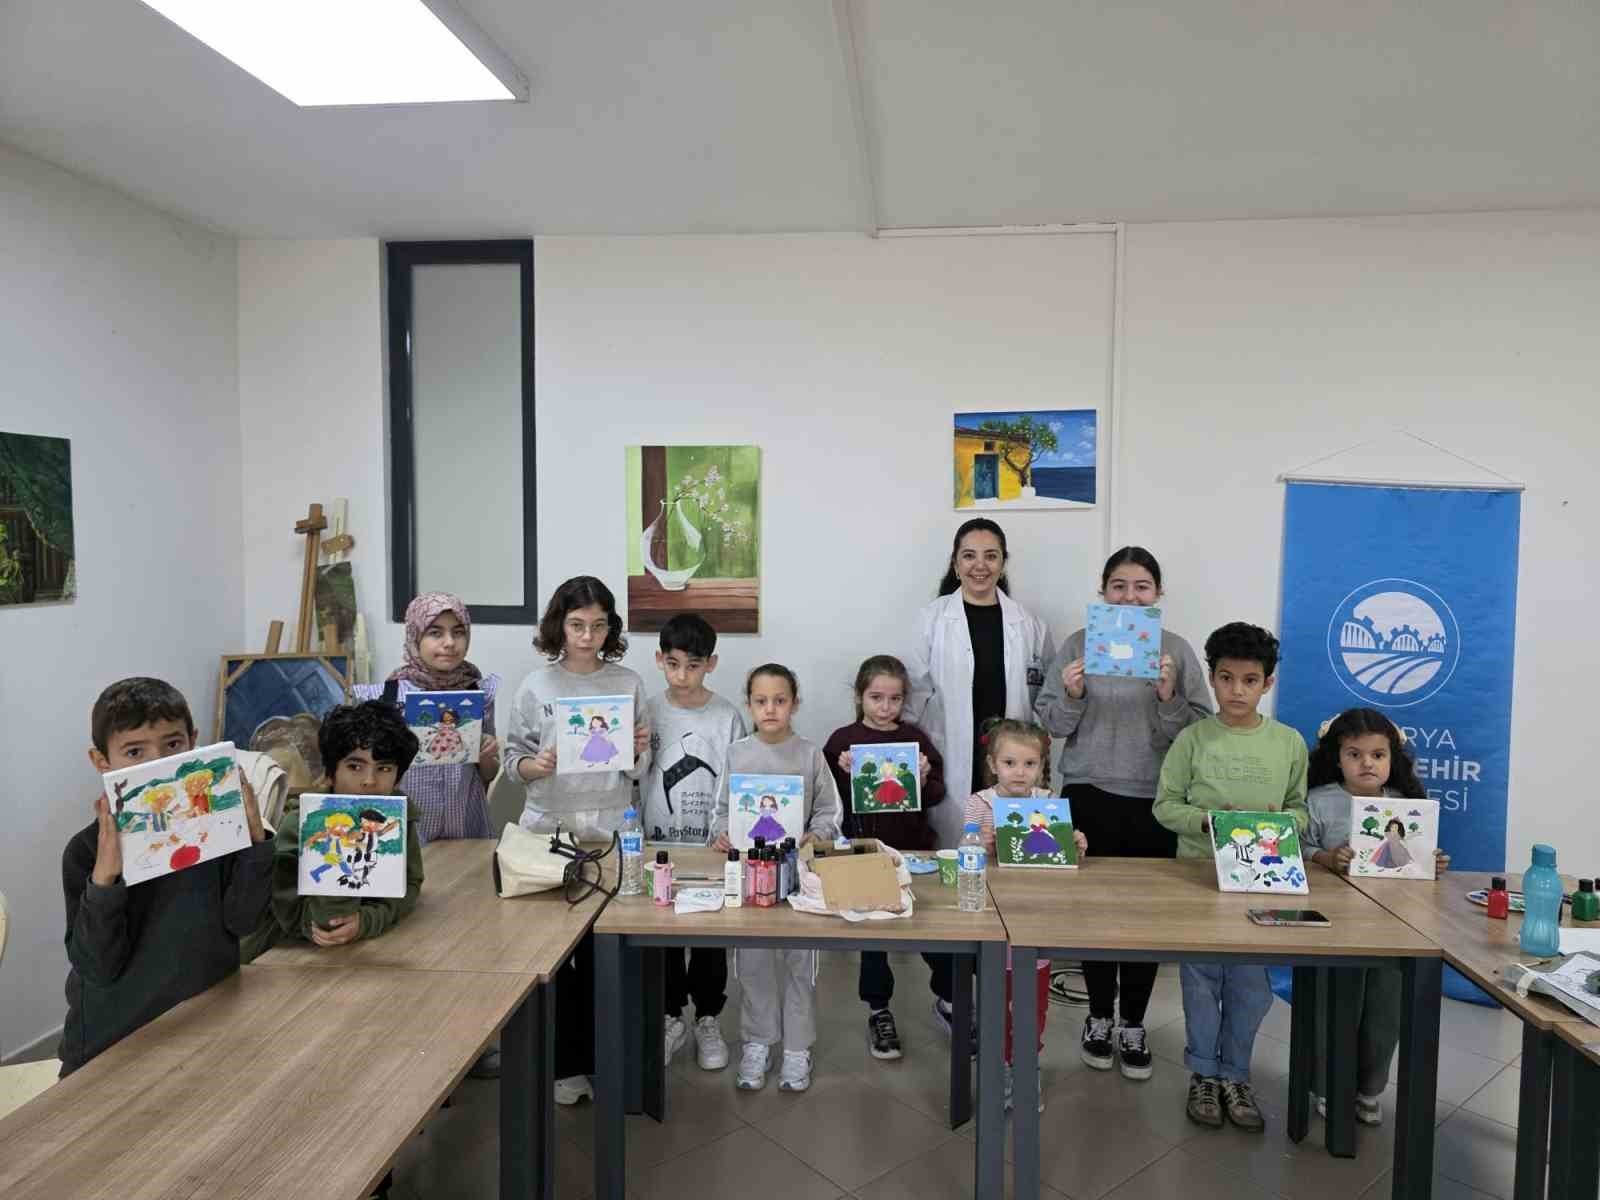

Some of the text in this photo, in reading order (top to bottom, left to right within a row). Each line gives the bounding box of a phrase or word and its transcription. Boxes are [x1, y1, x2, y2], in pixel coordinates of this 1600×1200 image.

[1402, 726, 1456, 750] RYA
[1413, 755, 1481, 782] EHİR
[1426, 786, 1468, 812] ESİ
